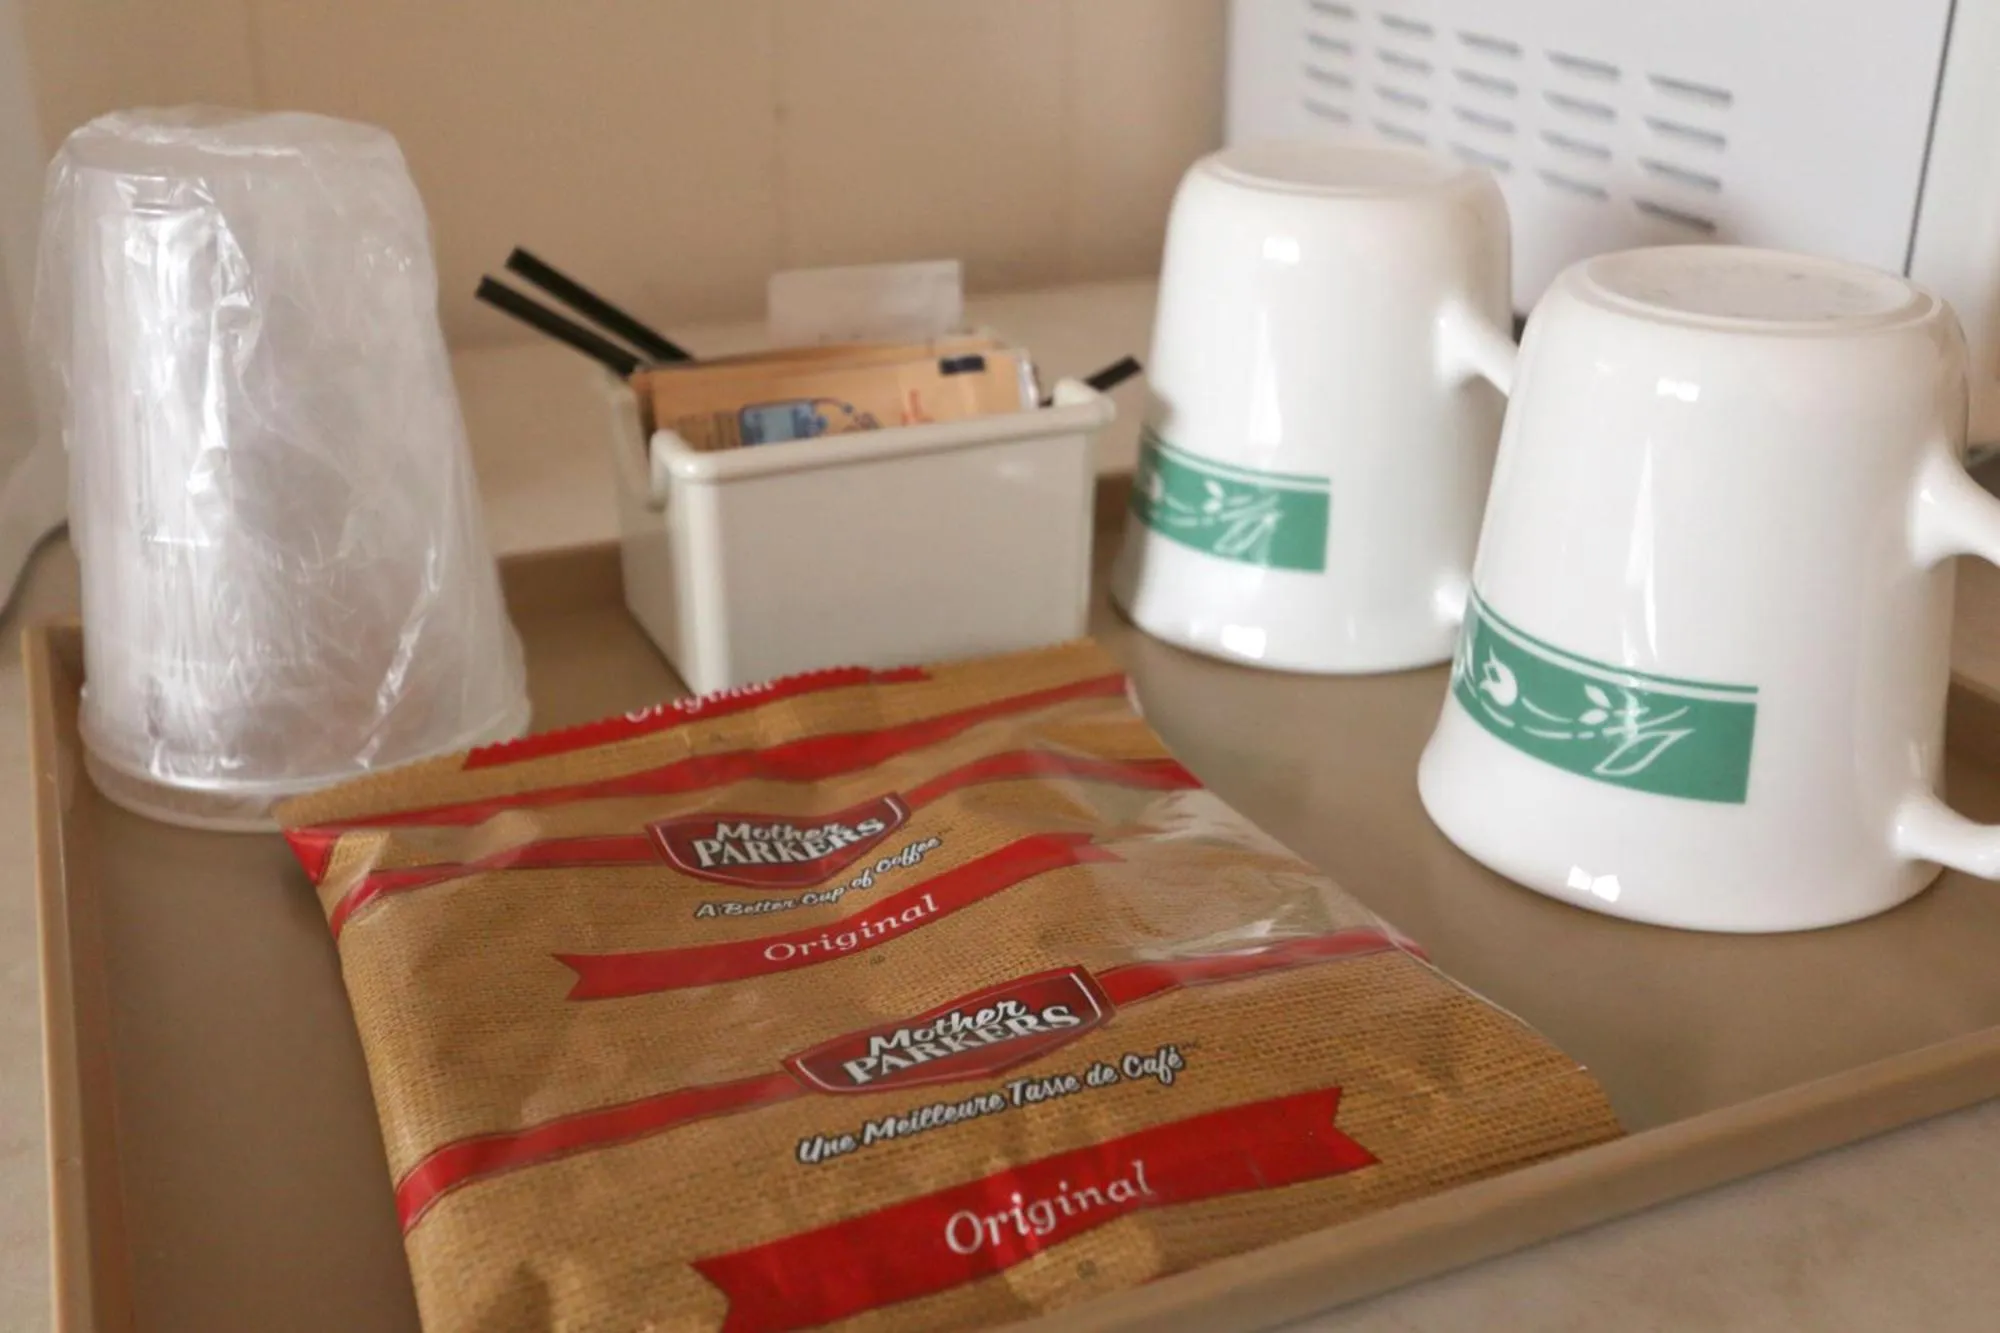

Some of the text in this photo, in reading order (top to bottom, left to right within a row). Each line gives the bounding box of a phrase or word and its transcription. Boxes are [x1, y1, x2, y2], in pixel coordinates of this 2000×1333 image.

[692, 816, 886, 868] PARKERS
[716, 820, 840, 842] Mother
[695, 903, 717, 919] A
[720, 898, 797, 917] Better
[801, 885, 846, 906] Cup
[850, 869, 874, 889] of
[763, 893, 940, 962] Original
[842, 1003, 1083, 1086] PARKERS
[869, 997, 1026, 1059] Mother
[798, 1044, 1184, 1164] Une Meilleure Tasse de Café
[944, 1158, 1158, 1256] Original
